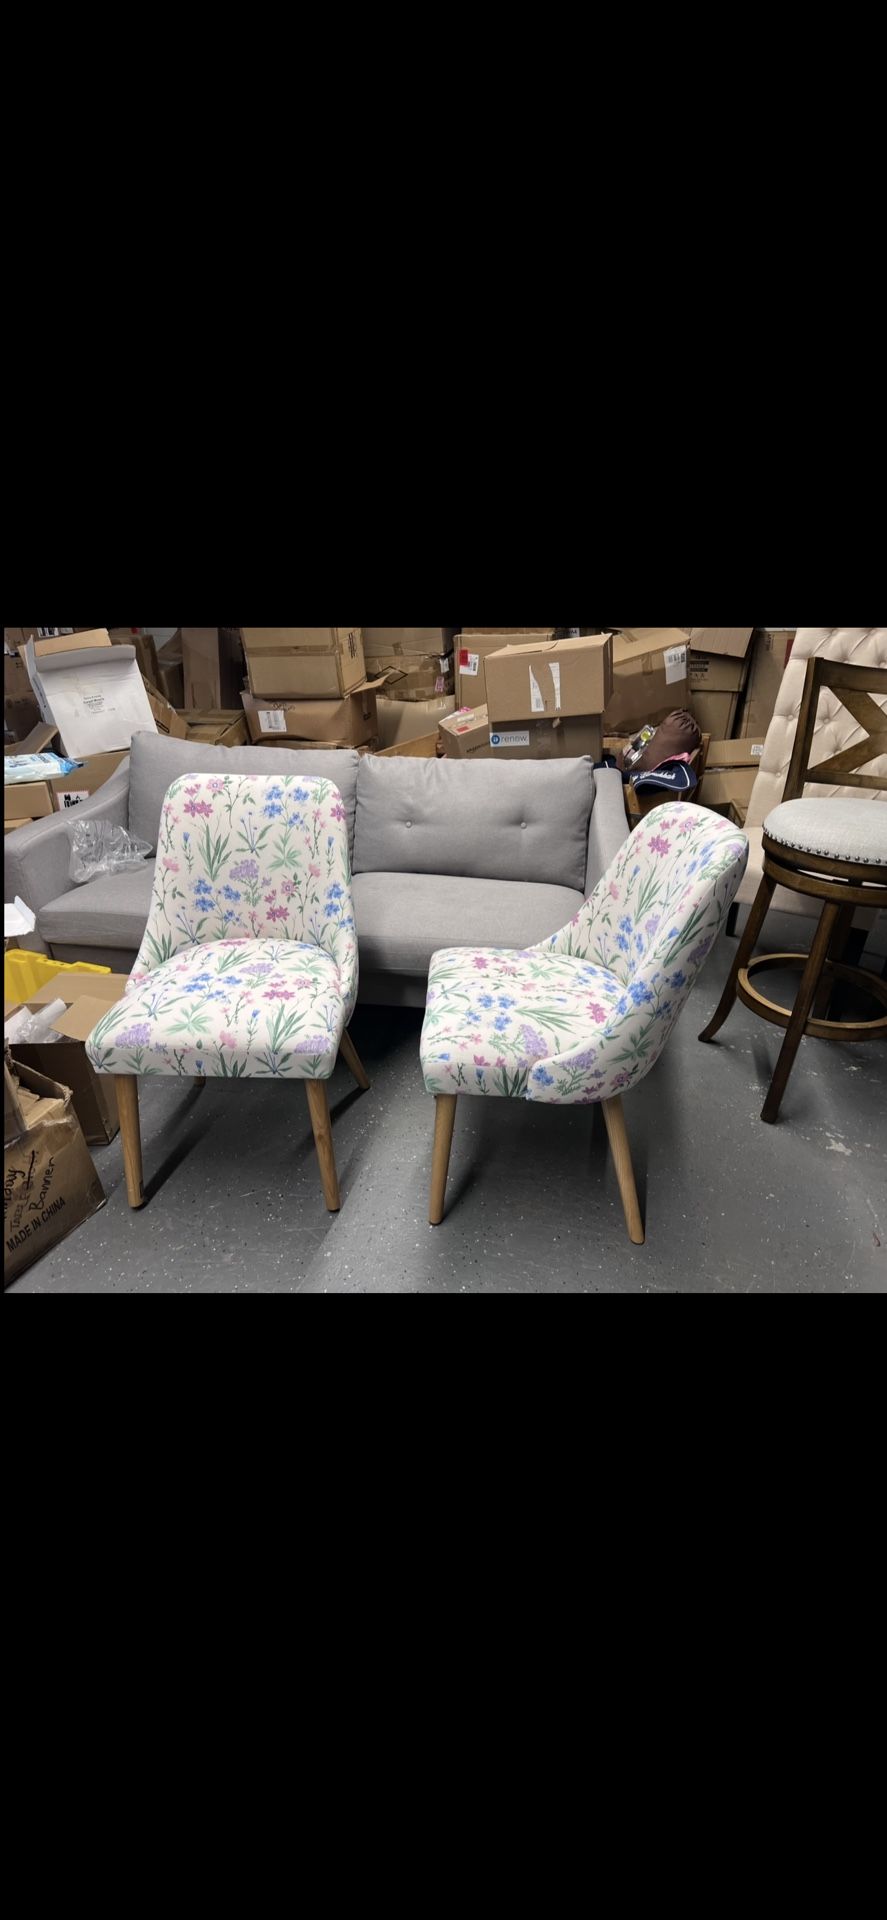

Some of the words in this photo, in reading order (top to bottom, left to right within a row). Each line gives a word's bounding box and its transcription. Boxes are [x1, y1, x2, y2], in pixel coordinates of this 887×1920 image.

[28, 1156, 56, 1211] Banner
[6, 1224, 33, 1252] MADE
[31, 1216, 41, 1231] IN
[41, 1196, 66, 1223] CHINA
